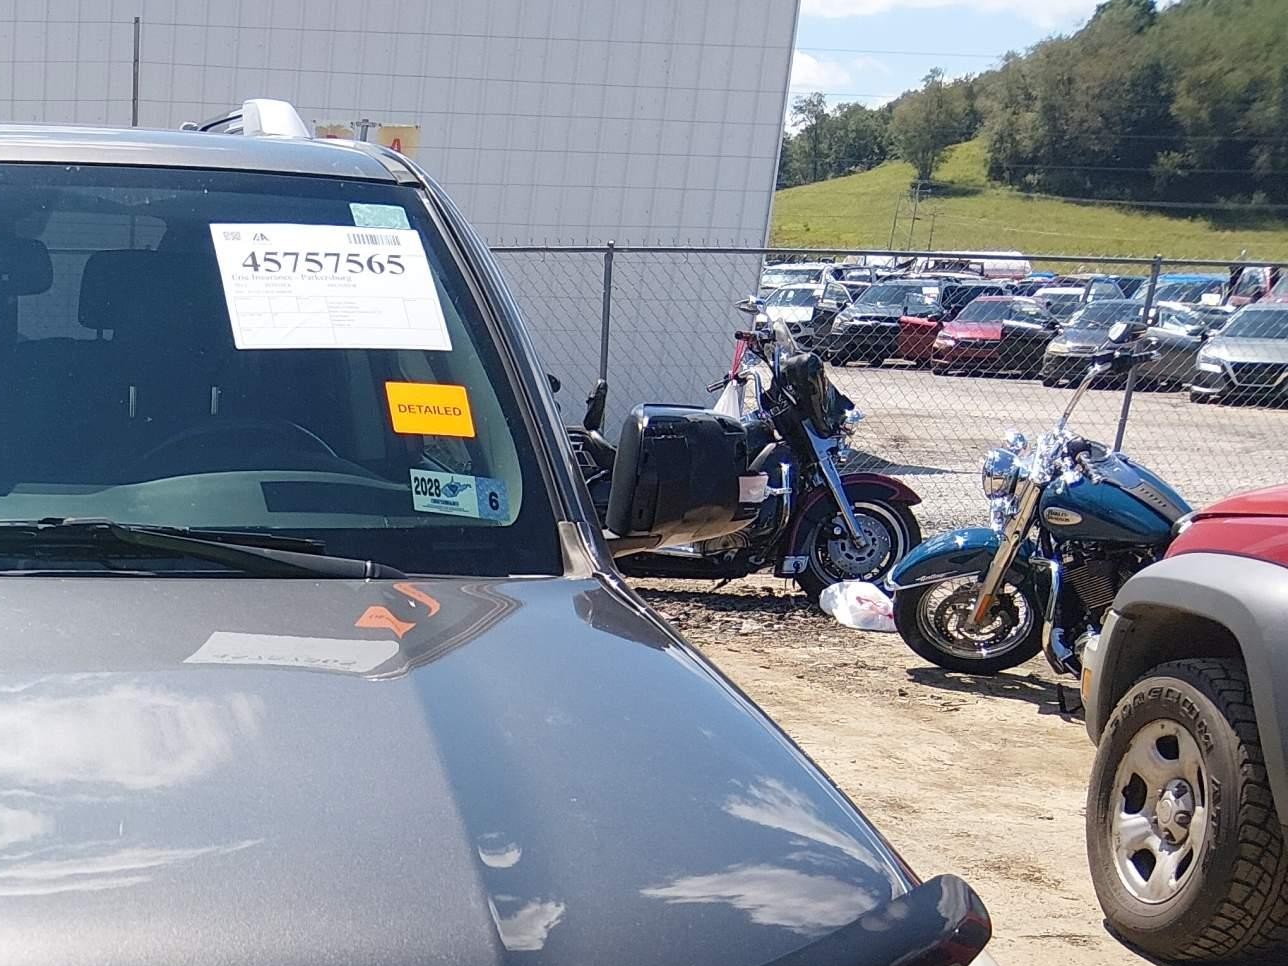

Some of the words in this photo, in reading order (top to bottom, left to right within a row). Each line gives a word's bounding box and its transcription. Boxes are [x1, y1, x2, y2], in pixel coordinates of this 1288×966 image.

[242, 251, 405, 275] 45757565
[398, 403, 462, 417] DETAILED
[413, 476, 442, 498] 2028
[488, 491, 500, 511] 6
